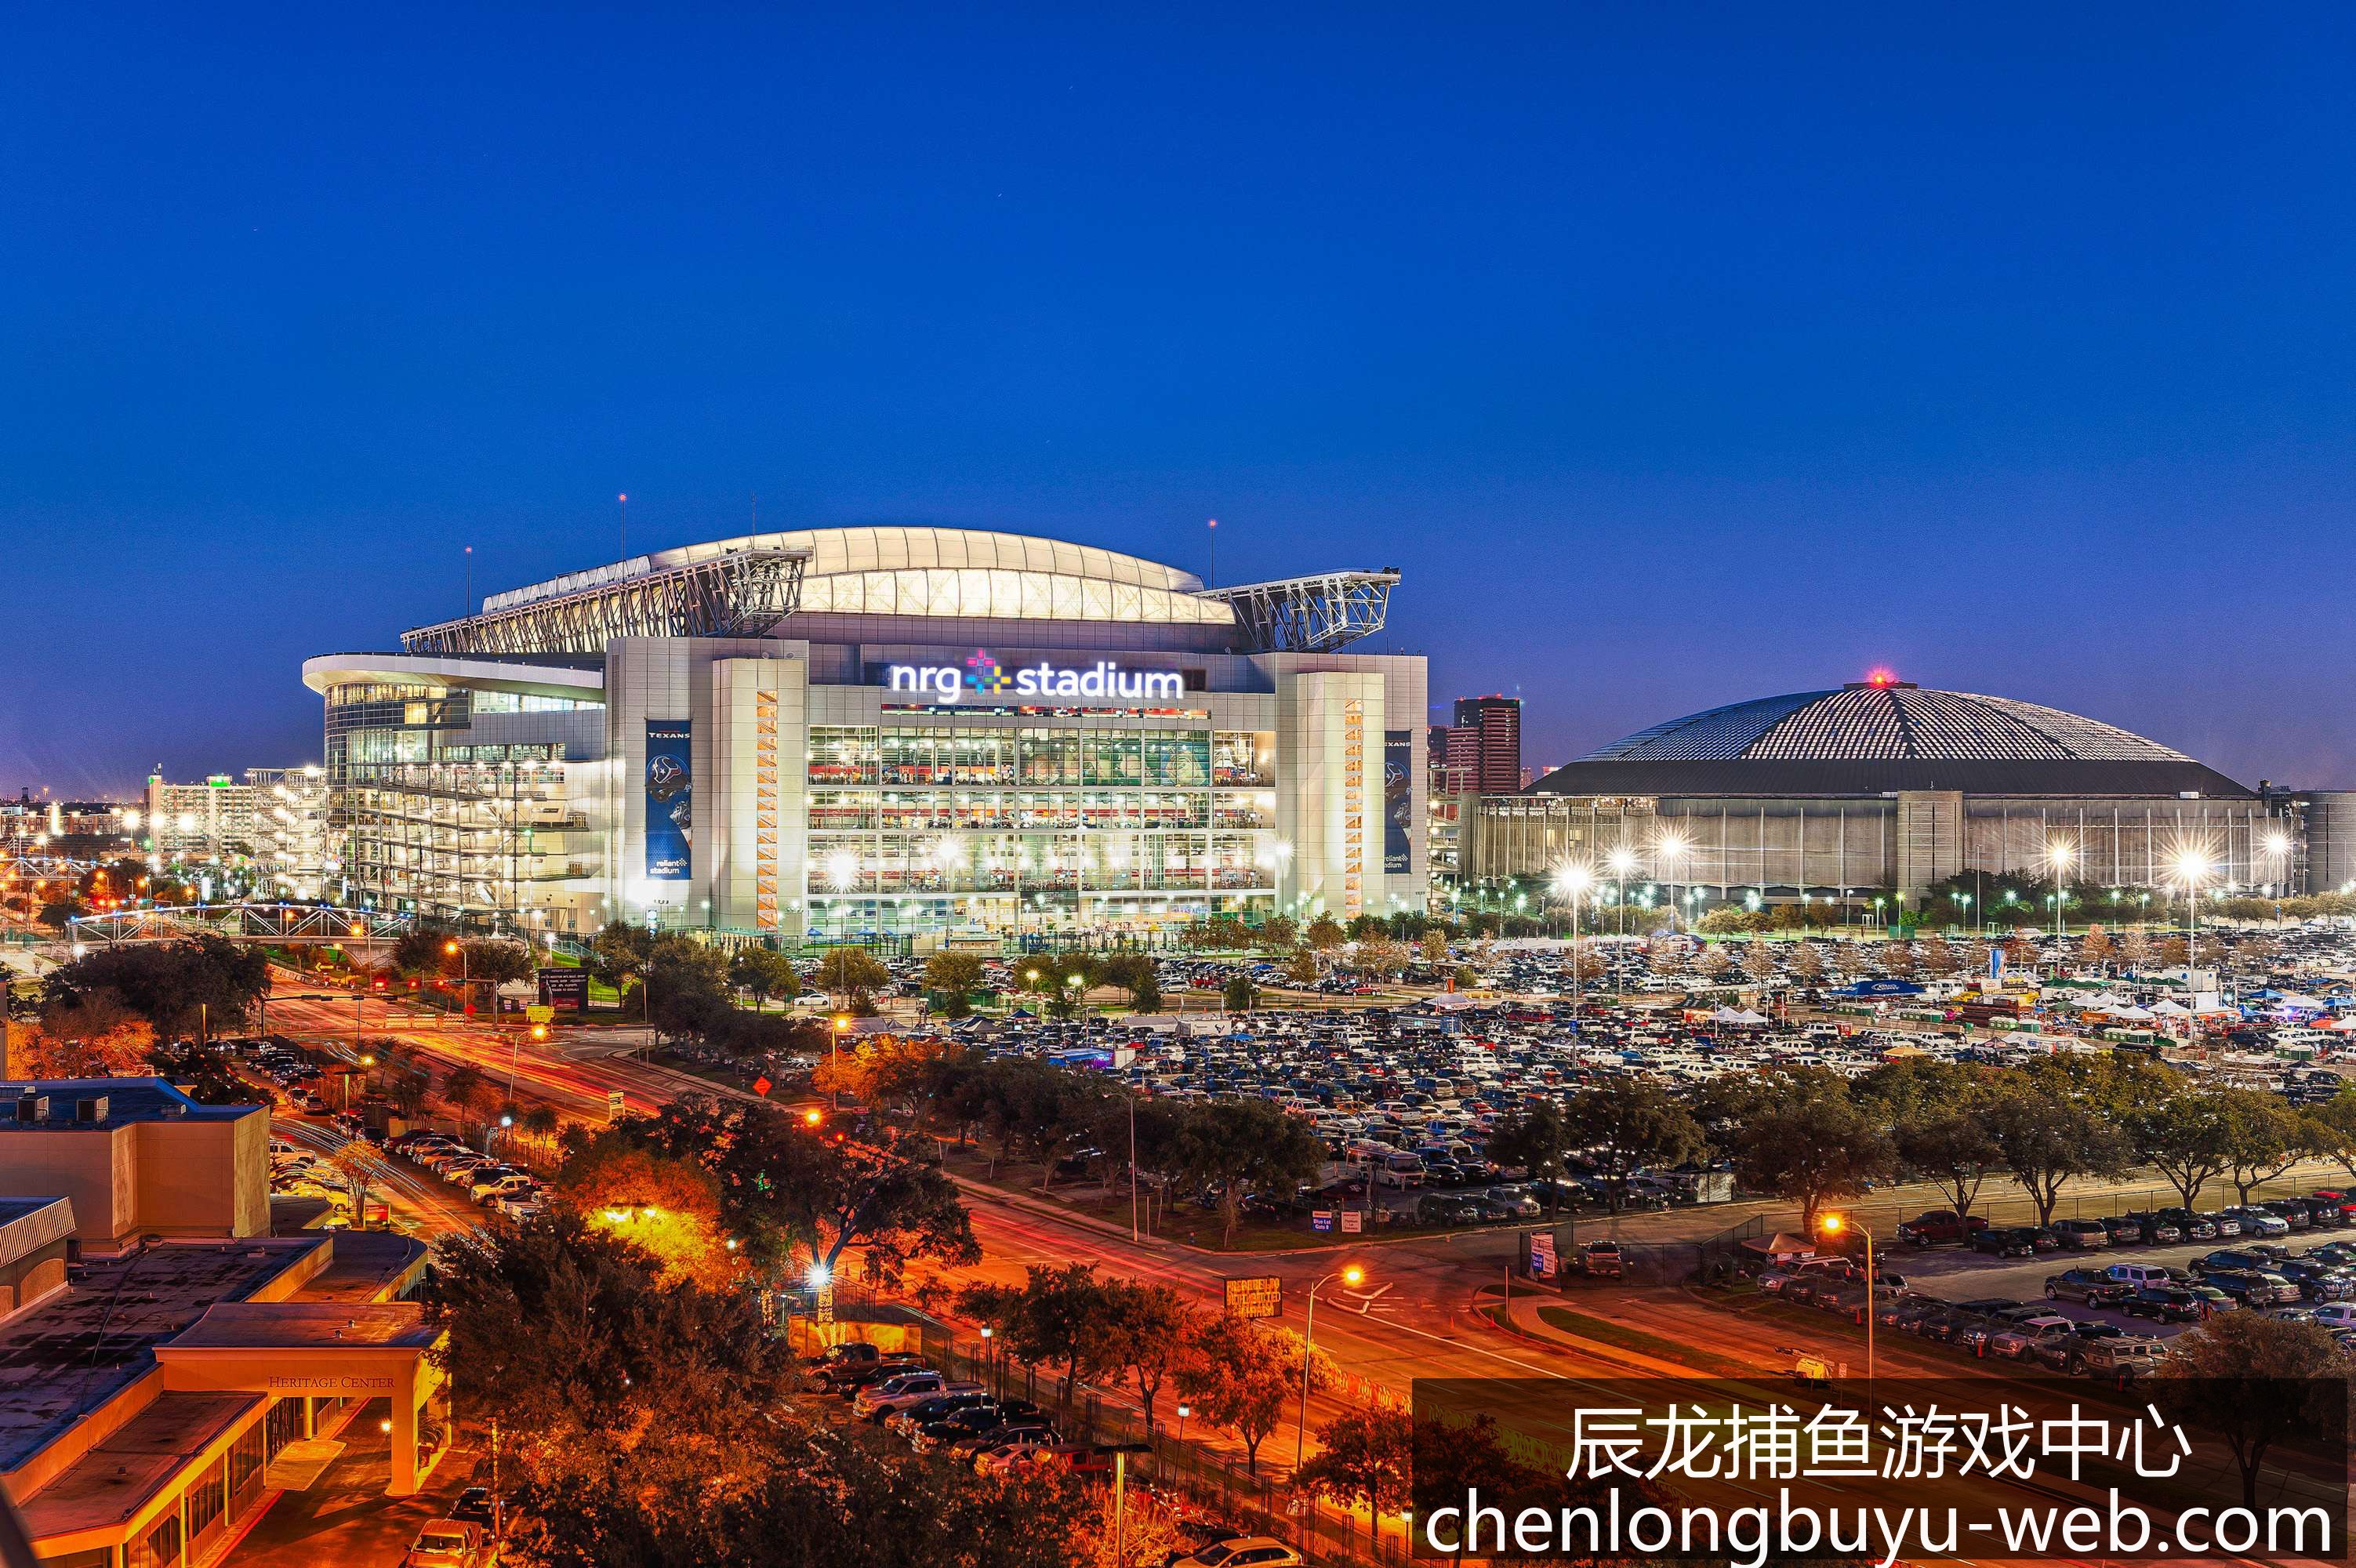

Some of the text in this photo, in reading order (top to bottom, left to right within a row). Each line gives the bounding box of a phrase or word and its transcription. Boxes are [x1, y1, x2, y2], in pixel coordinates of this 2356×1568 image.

[891, 660, 1185, 704] nrg stadium
[269, 1376, 394, 1388] HERITAGE CENTER
